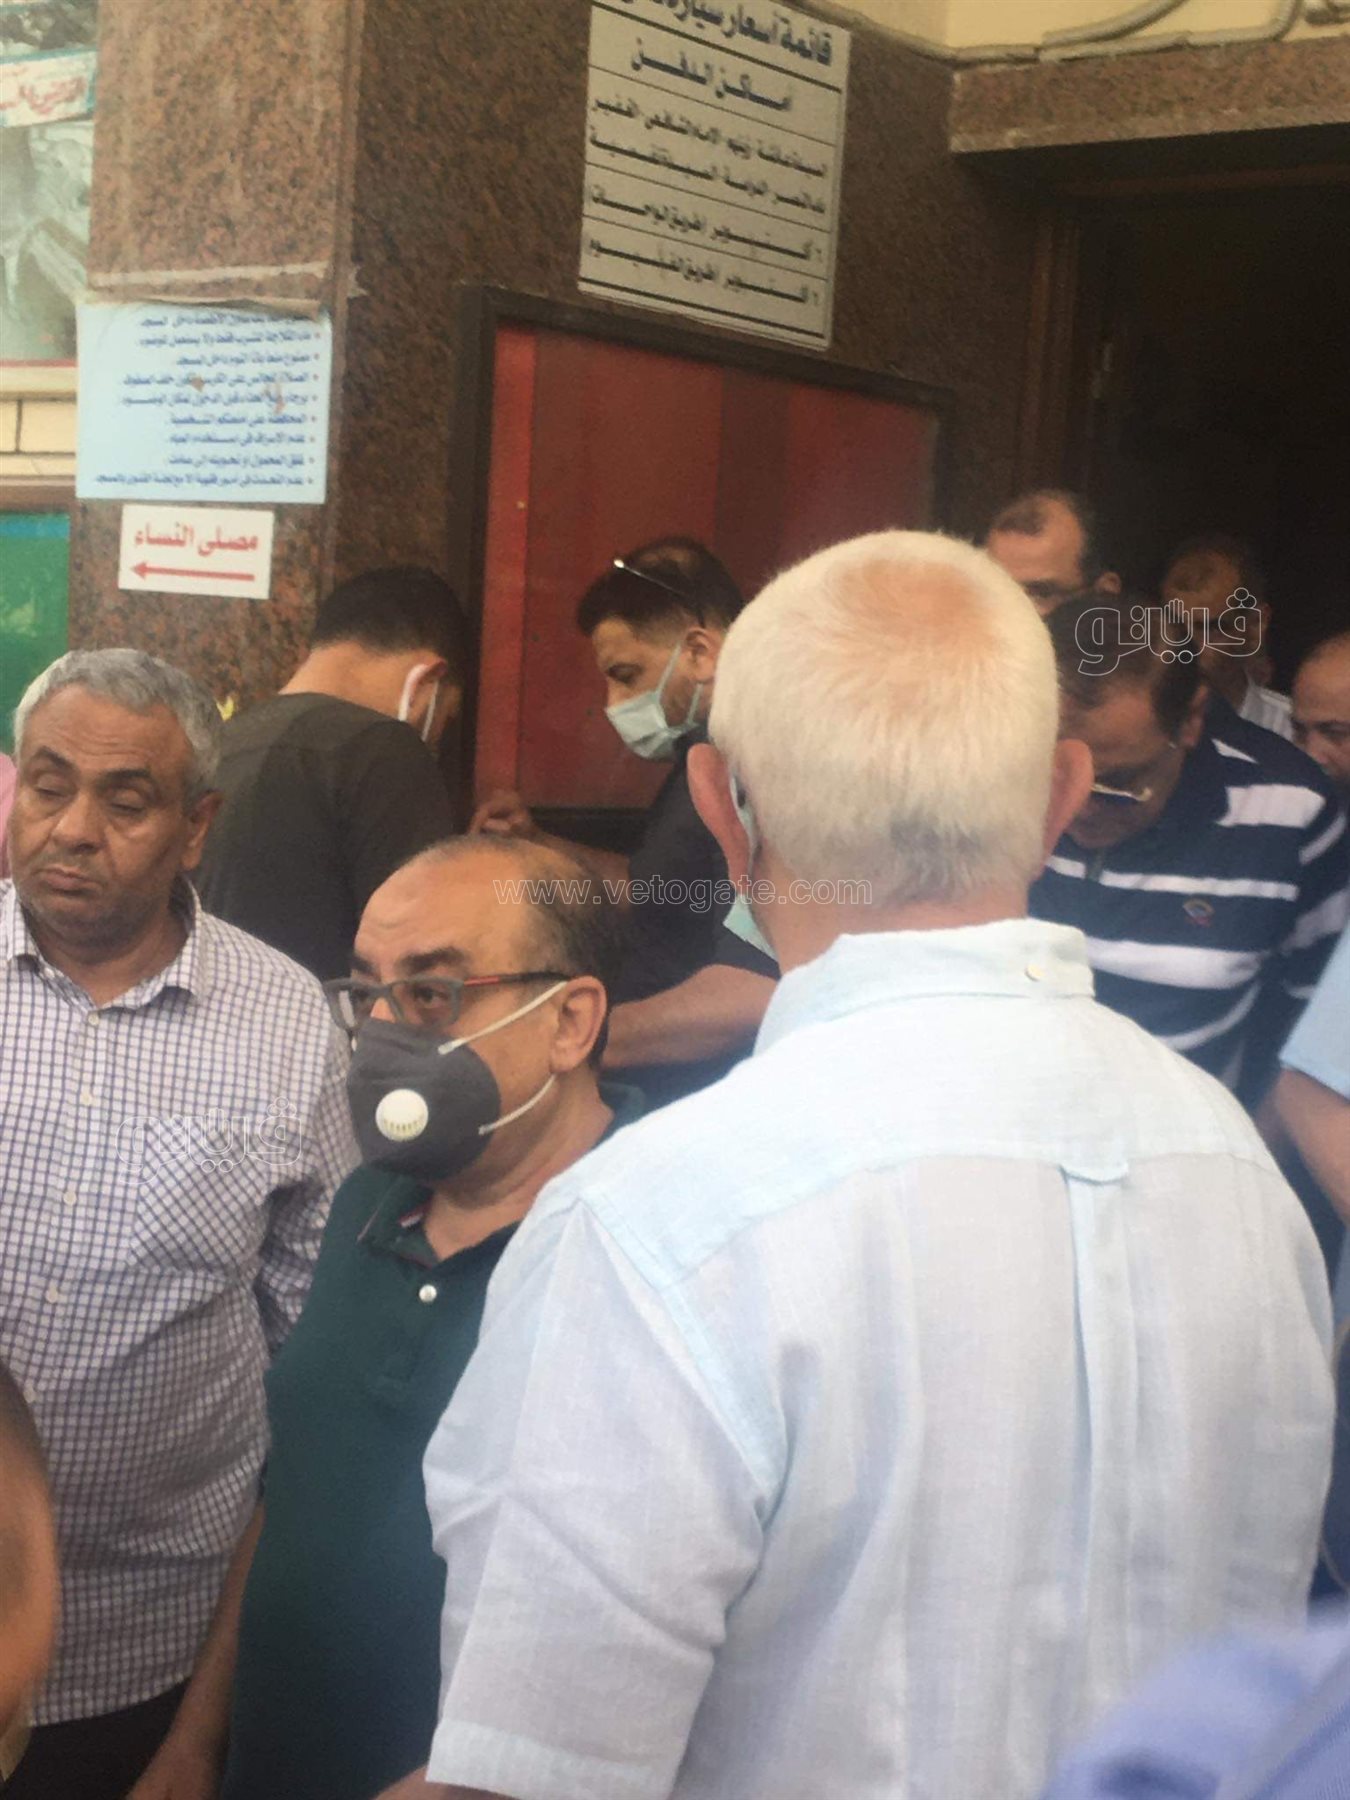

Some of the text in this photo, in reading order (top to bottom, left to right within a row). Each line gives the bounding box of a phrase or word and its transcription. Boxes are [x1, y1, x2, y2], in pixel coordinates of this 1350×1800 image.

[774, 11, 832, 66] قائمة
[134, 522, 258, 556] مصلى النساء
